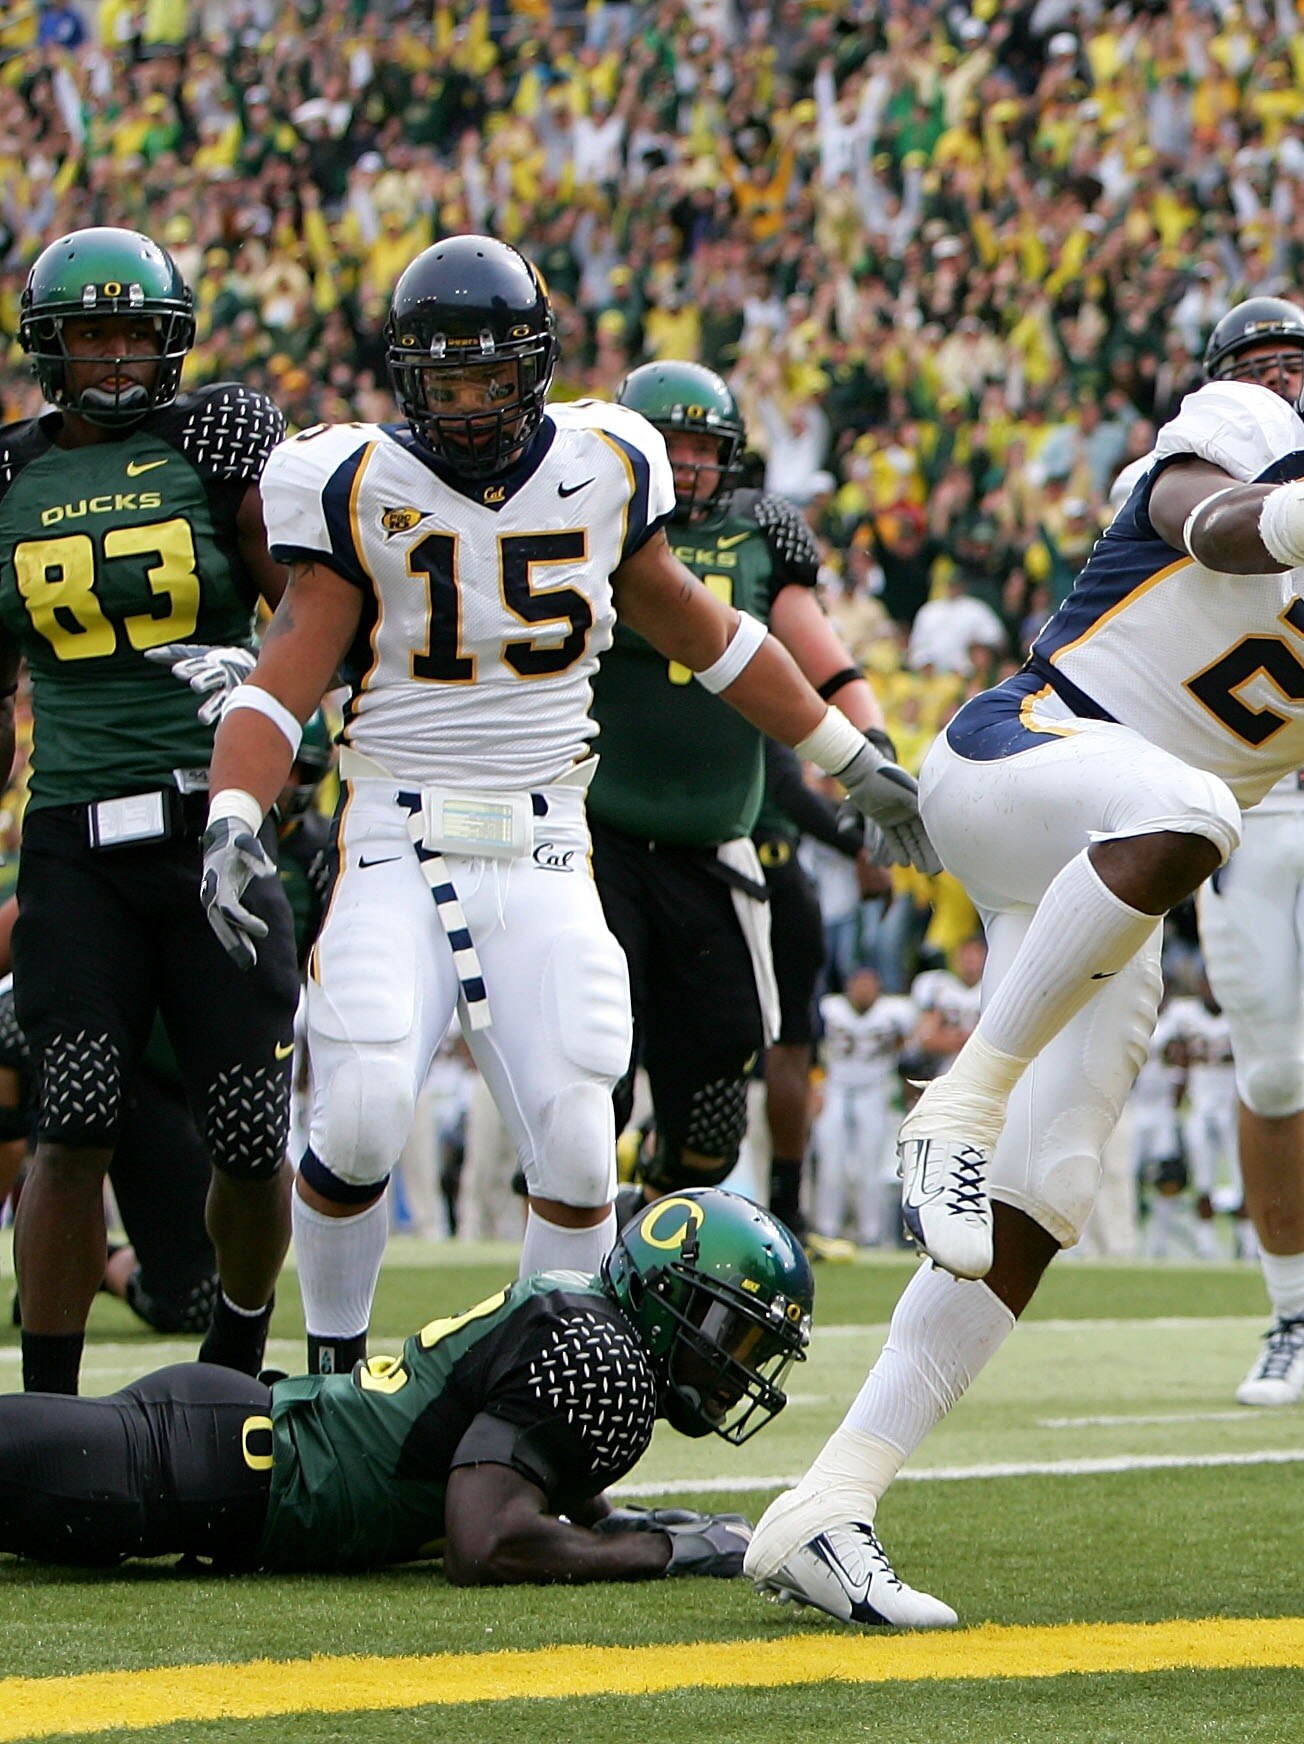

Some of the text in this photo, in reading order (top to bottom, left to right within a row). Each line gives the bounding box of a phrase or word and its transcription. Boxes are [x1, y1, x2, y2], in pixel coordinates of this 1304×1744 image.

[41, 492, 161, 527] DUCKS
[483, 486, 505, 504] Cal
[13, 517, 201, 662] 83
[405, 527, 595, 684] 15
[533, 843, 574, 872] Cal
